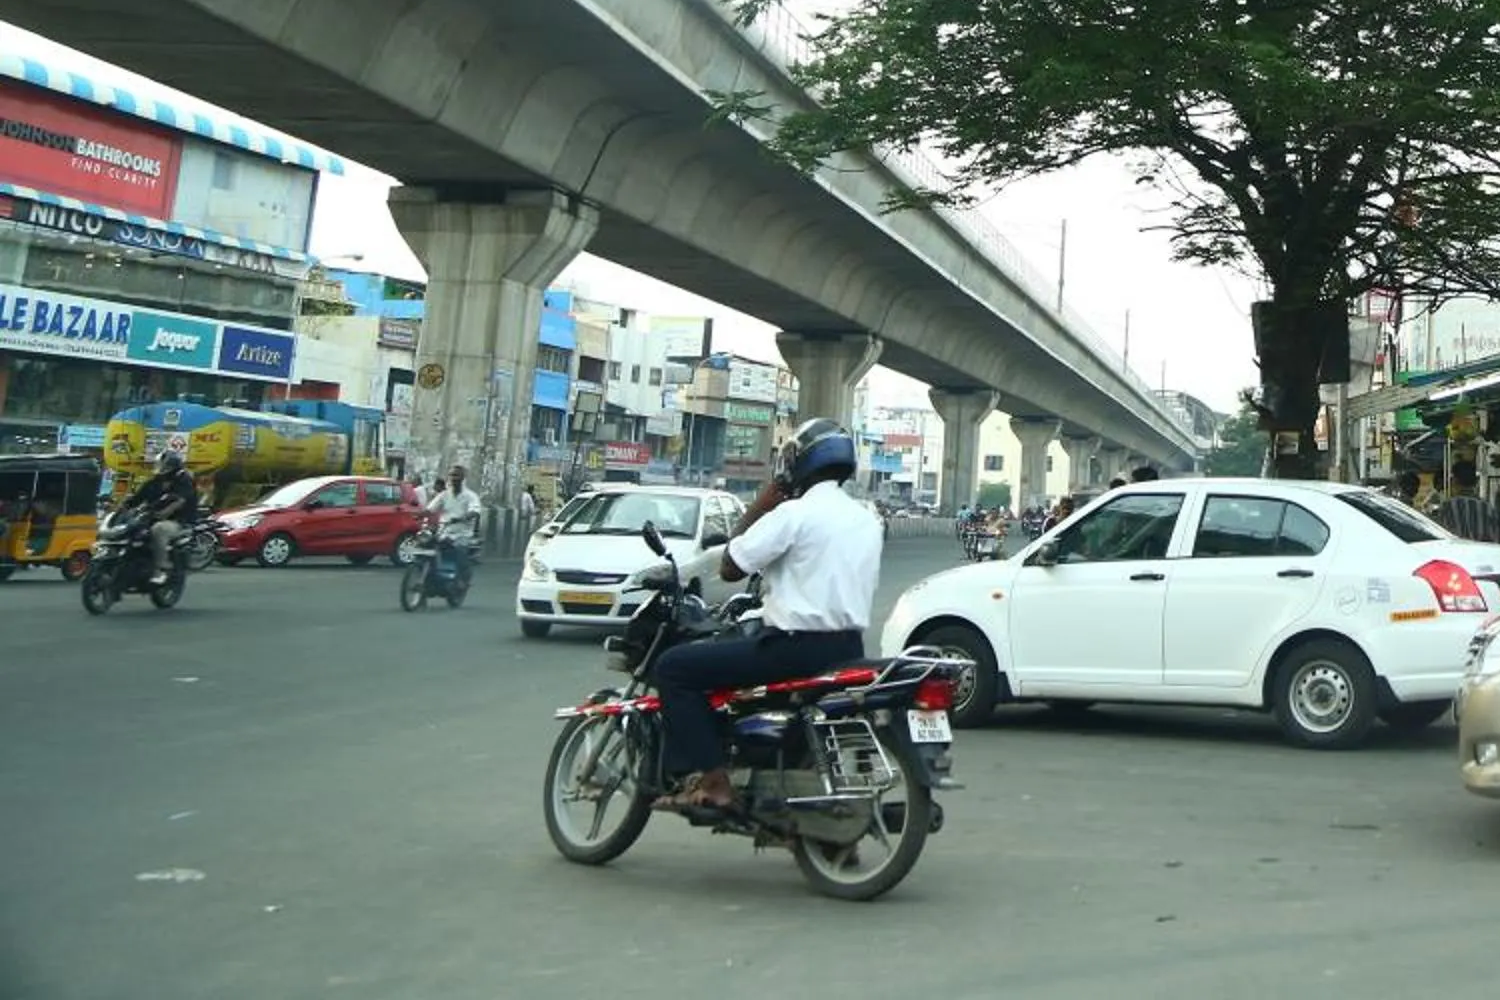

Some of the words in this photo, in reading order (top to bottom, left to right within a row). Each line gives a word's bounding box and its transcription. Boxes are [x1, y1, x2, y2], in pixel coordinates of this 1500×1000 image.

[76, 137, 161, 177] BATHROOMS
[31, 300, 132, 344] BAZAAR
[235, 342, 282, 366] Artize
